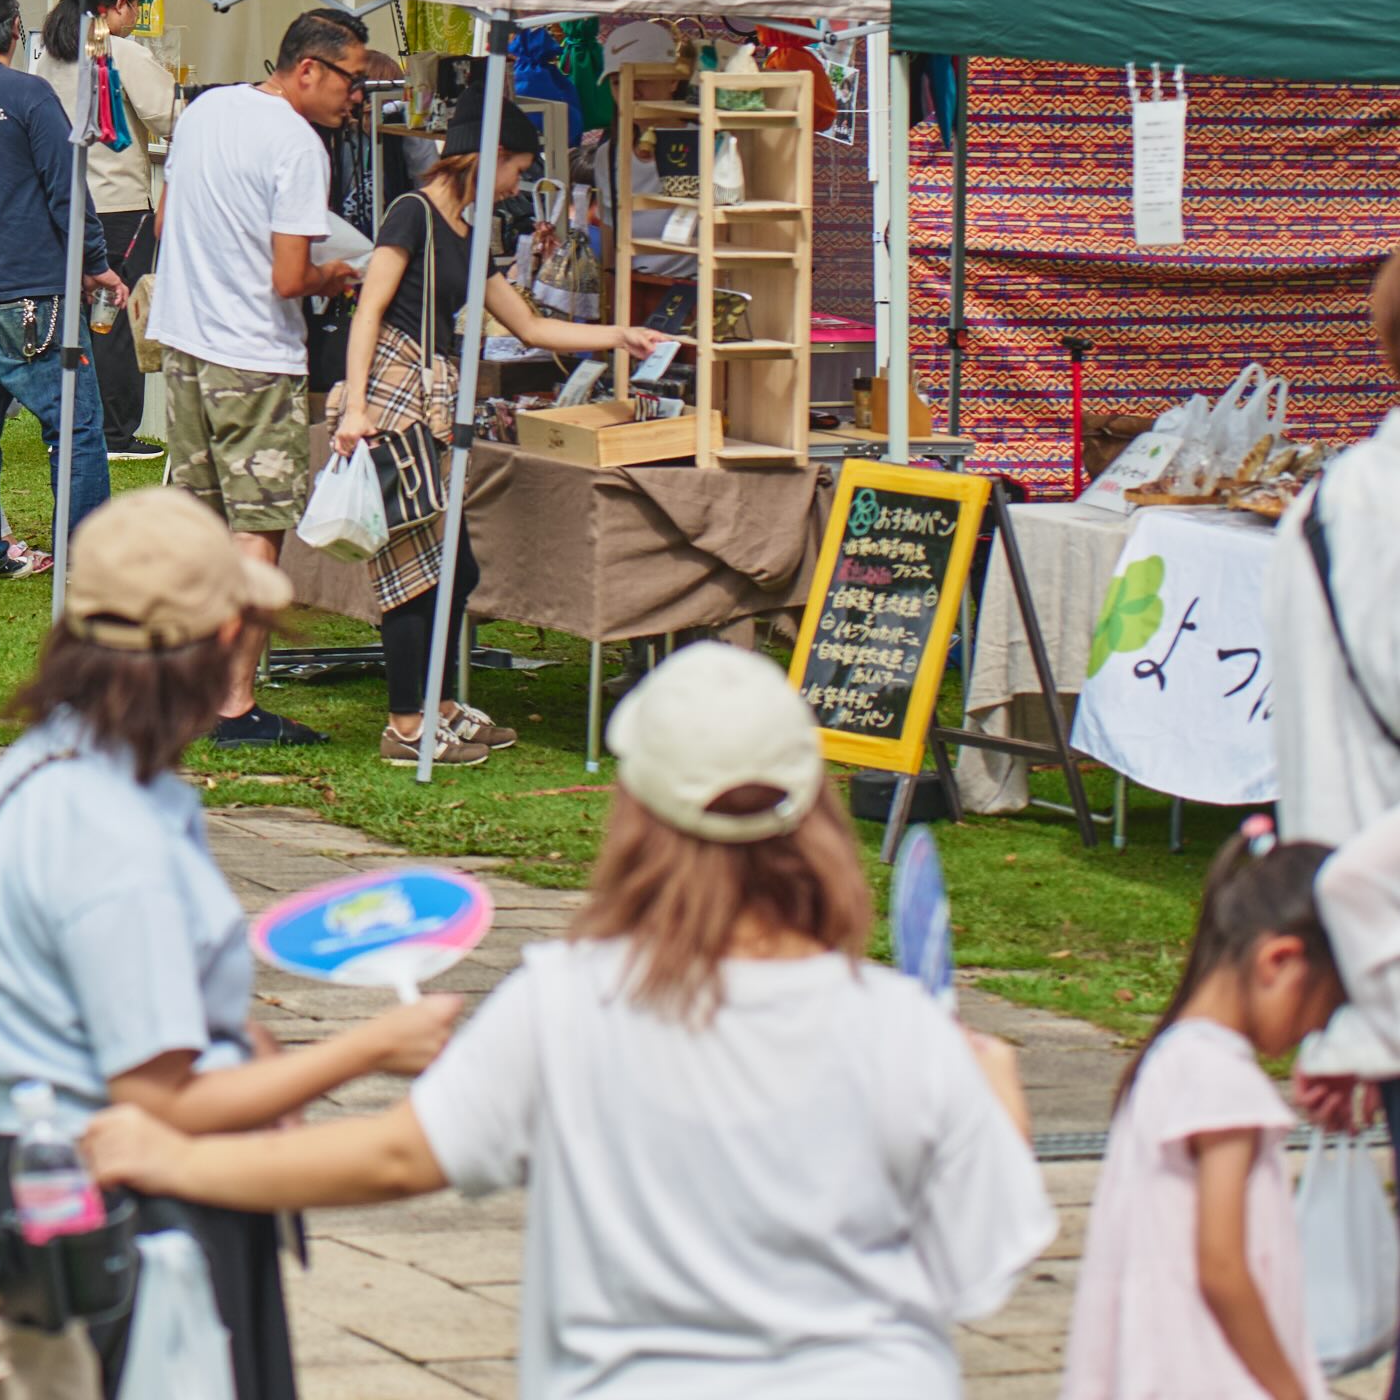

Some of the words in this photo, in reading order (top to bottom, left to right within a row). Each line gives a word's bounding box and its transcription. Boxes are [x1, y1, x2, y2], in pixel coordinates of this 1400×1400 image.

[874, 506, 956, 534] おすすめパン
